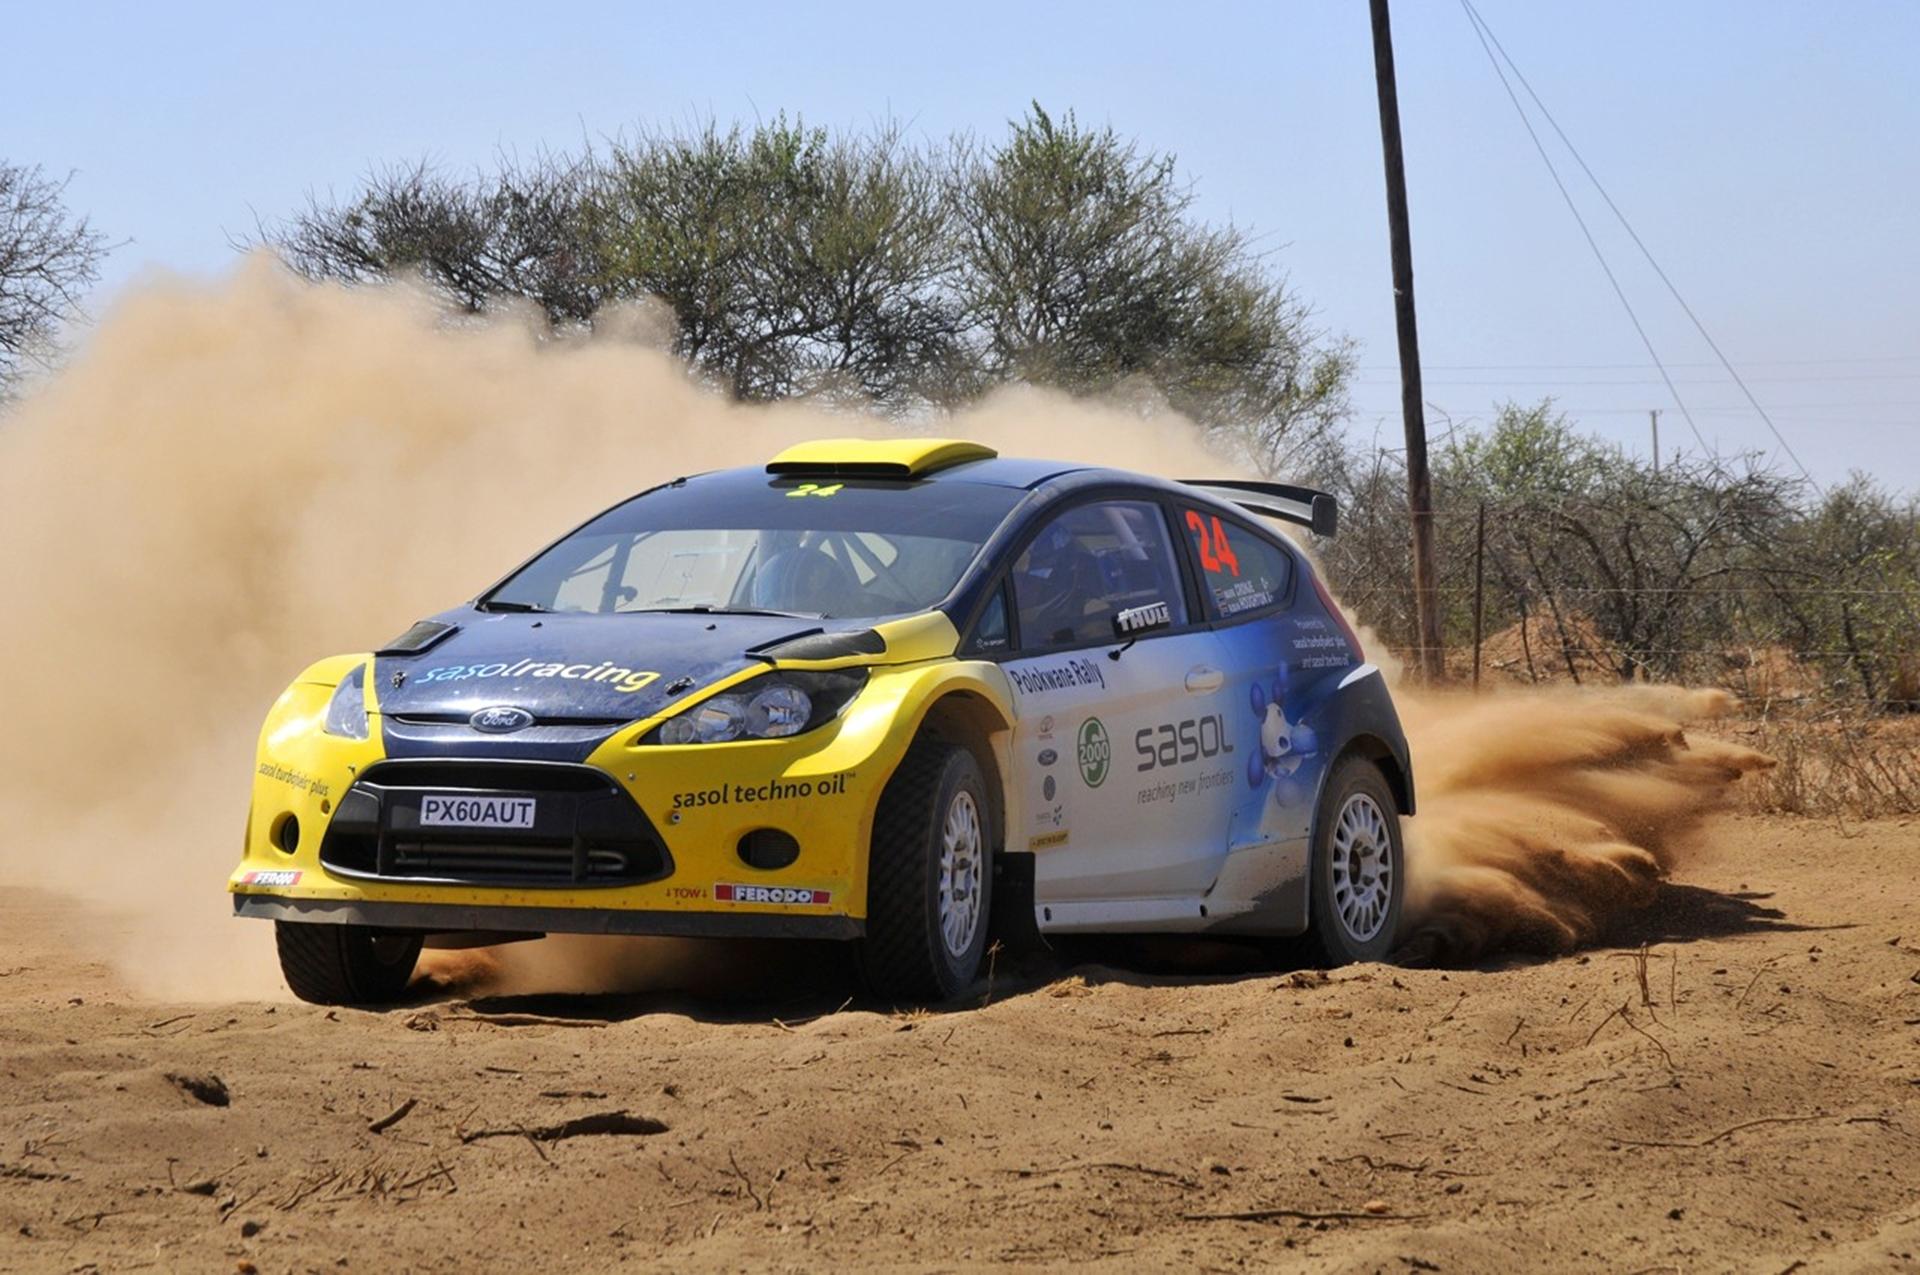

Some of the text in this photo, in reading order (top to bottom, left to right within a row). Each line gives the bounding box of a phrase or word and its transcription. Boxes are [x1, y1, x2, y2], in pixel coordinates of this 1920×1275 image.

[785, 484, 844, 497] 24
[1185, 510, 1240, 577] 24
[1117, 602, 1170, 631] THULE
[1010, 657, 1105, 695] Polokwane Rally
[482, 710, 519, 727] Ford
[1079, 741, 1109, 764] 2000
[673, 784, 729, 809] sasol
[735, 780, 812, 803] techno
[1137, 769, 1234, 803] reaching new frontiers
[425, 800, 533, 823] PX60AUT
[674, 888, 702, 899] TOW
[734, 886, 812, 904] FERODO
